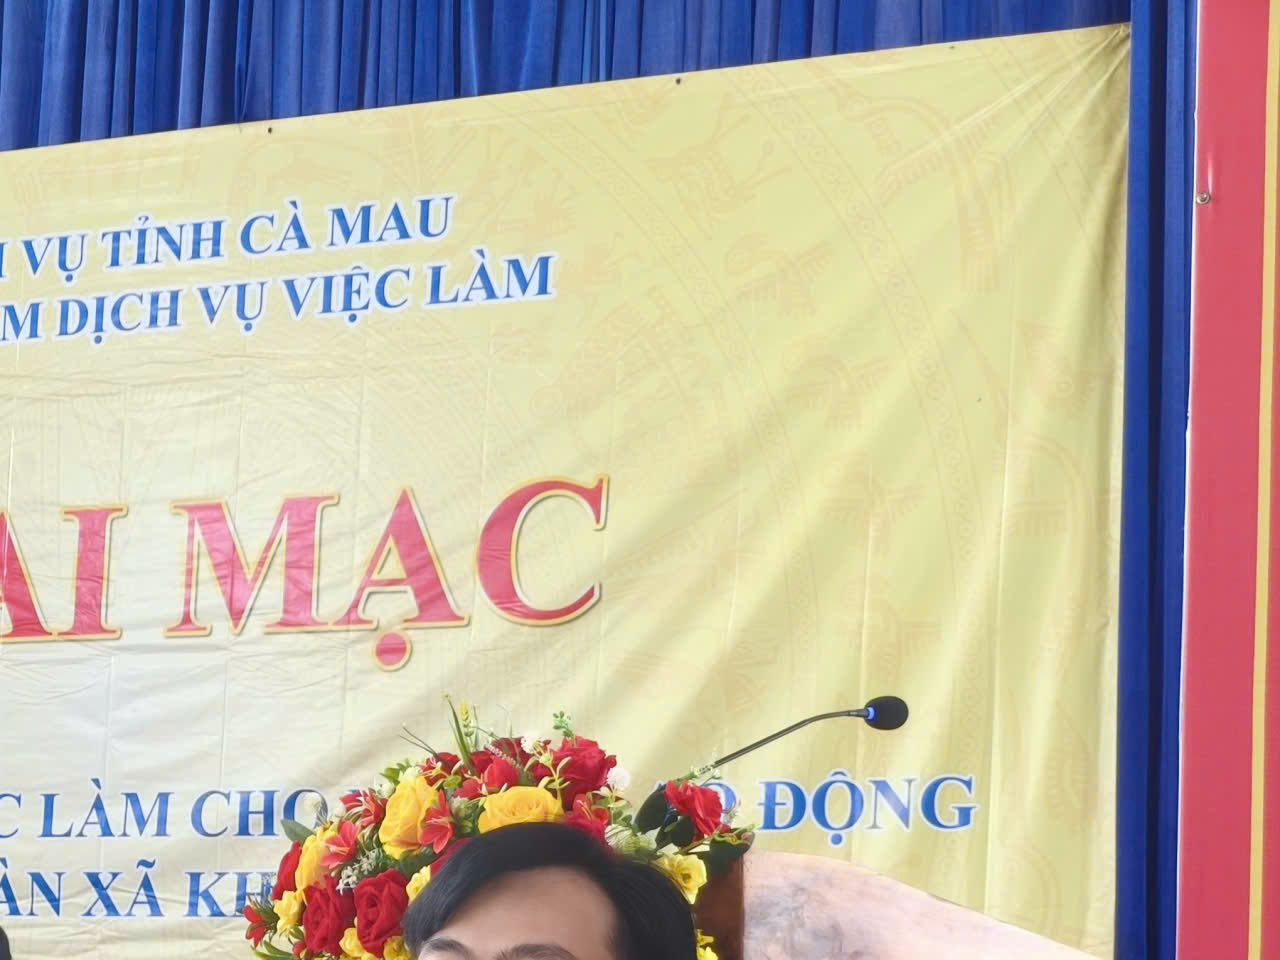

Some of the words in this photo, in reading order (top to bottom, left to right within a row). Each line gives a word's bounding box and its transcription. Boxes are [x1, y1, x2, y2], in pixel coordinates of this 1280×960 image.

[22, 234, 88, 283] VỤ
[102, 216, 224, 269] TỈNH
[240, 200, 311, 254] CÀ
[327, 197, 453, 247] MAU
[58, 288, 183, 344] DỊCH
[197, 281, 269, 332] VỤ
[282, 266, 411, 323] VIỆC
[425, 248, 553, 305] LÀM
[163, 473, 610, 672] MẠC
[37, 776, 173, 838] LÀM
[190, 788, 328, 837] CHO
[757, 770, 977, 845] ĐỘNG
[81, 859, 165, 917] XÃ
